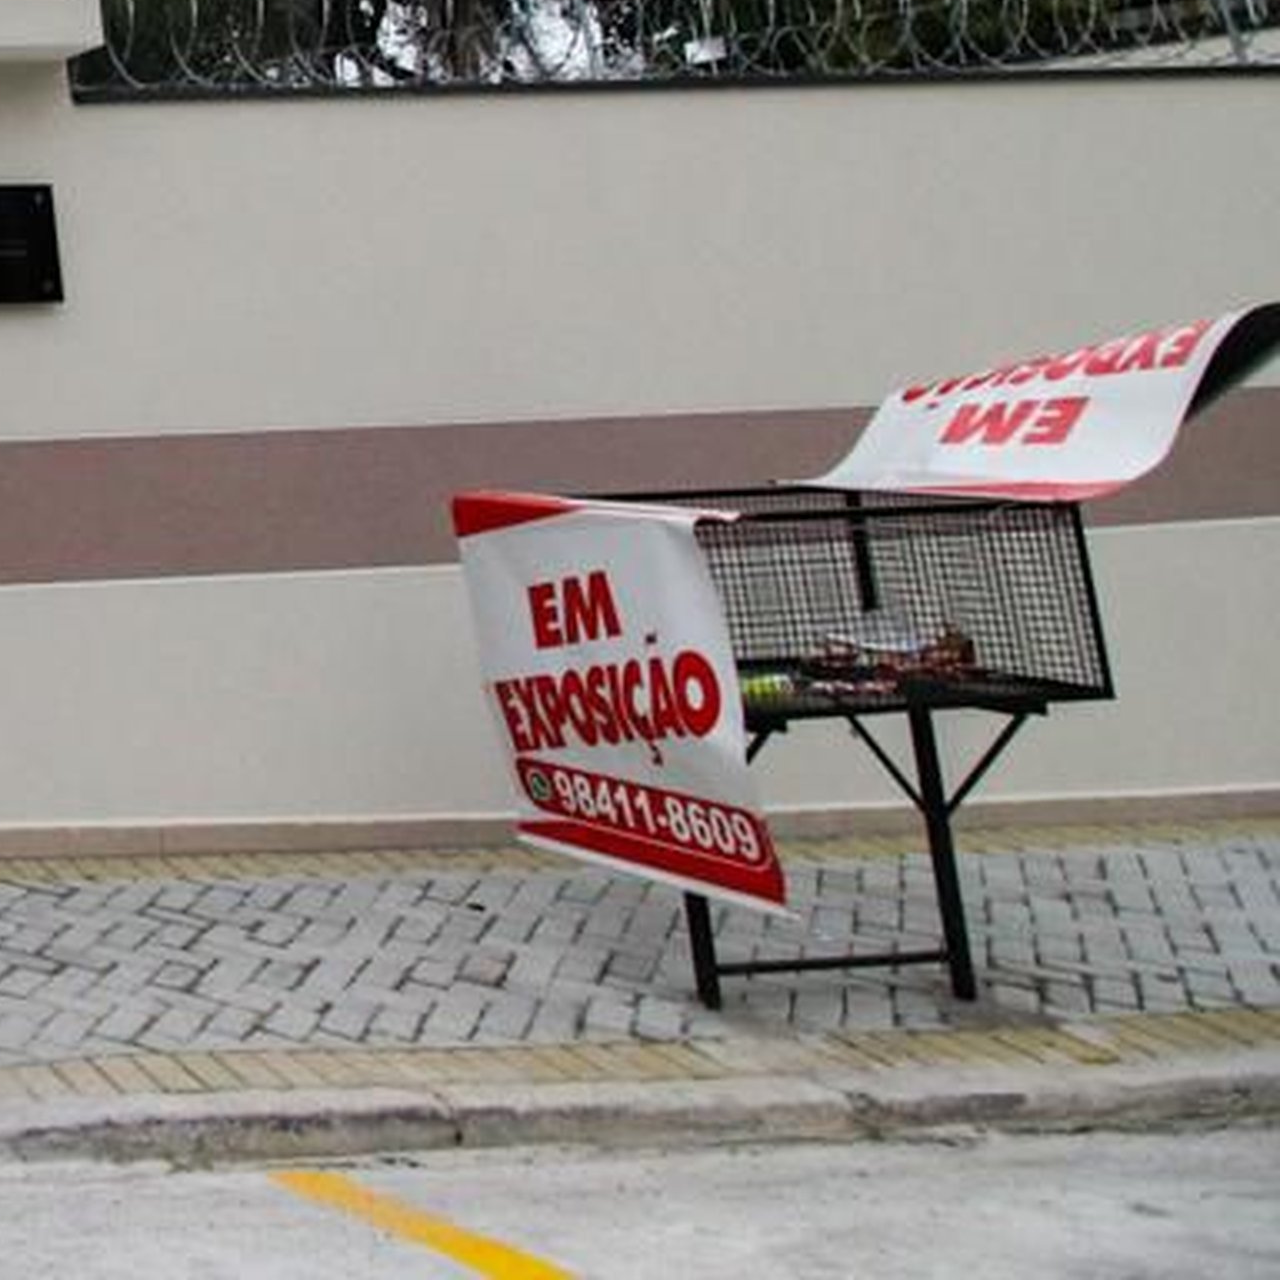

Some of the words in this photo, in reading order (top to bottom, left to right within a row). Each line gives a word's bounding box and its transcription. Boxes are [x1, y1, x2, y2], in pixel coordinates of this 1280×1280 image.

[940, 397, 1091, 444] EM
[528, 571, 622, 649] EM
[495, 632, 721, 766] EXPOSIÇÃO
[552, 771, 760, 860] 98411-8609
